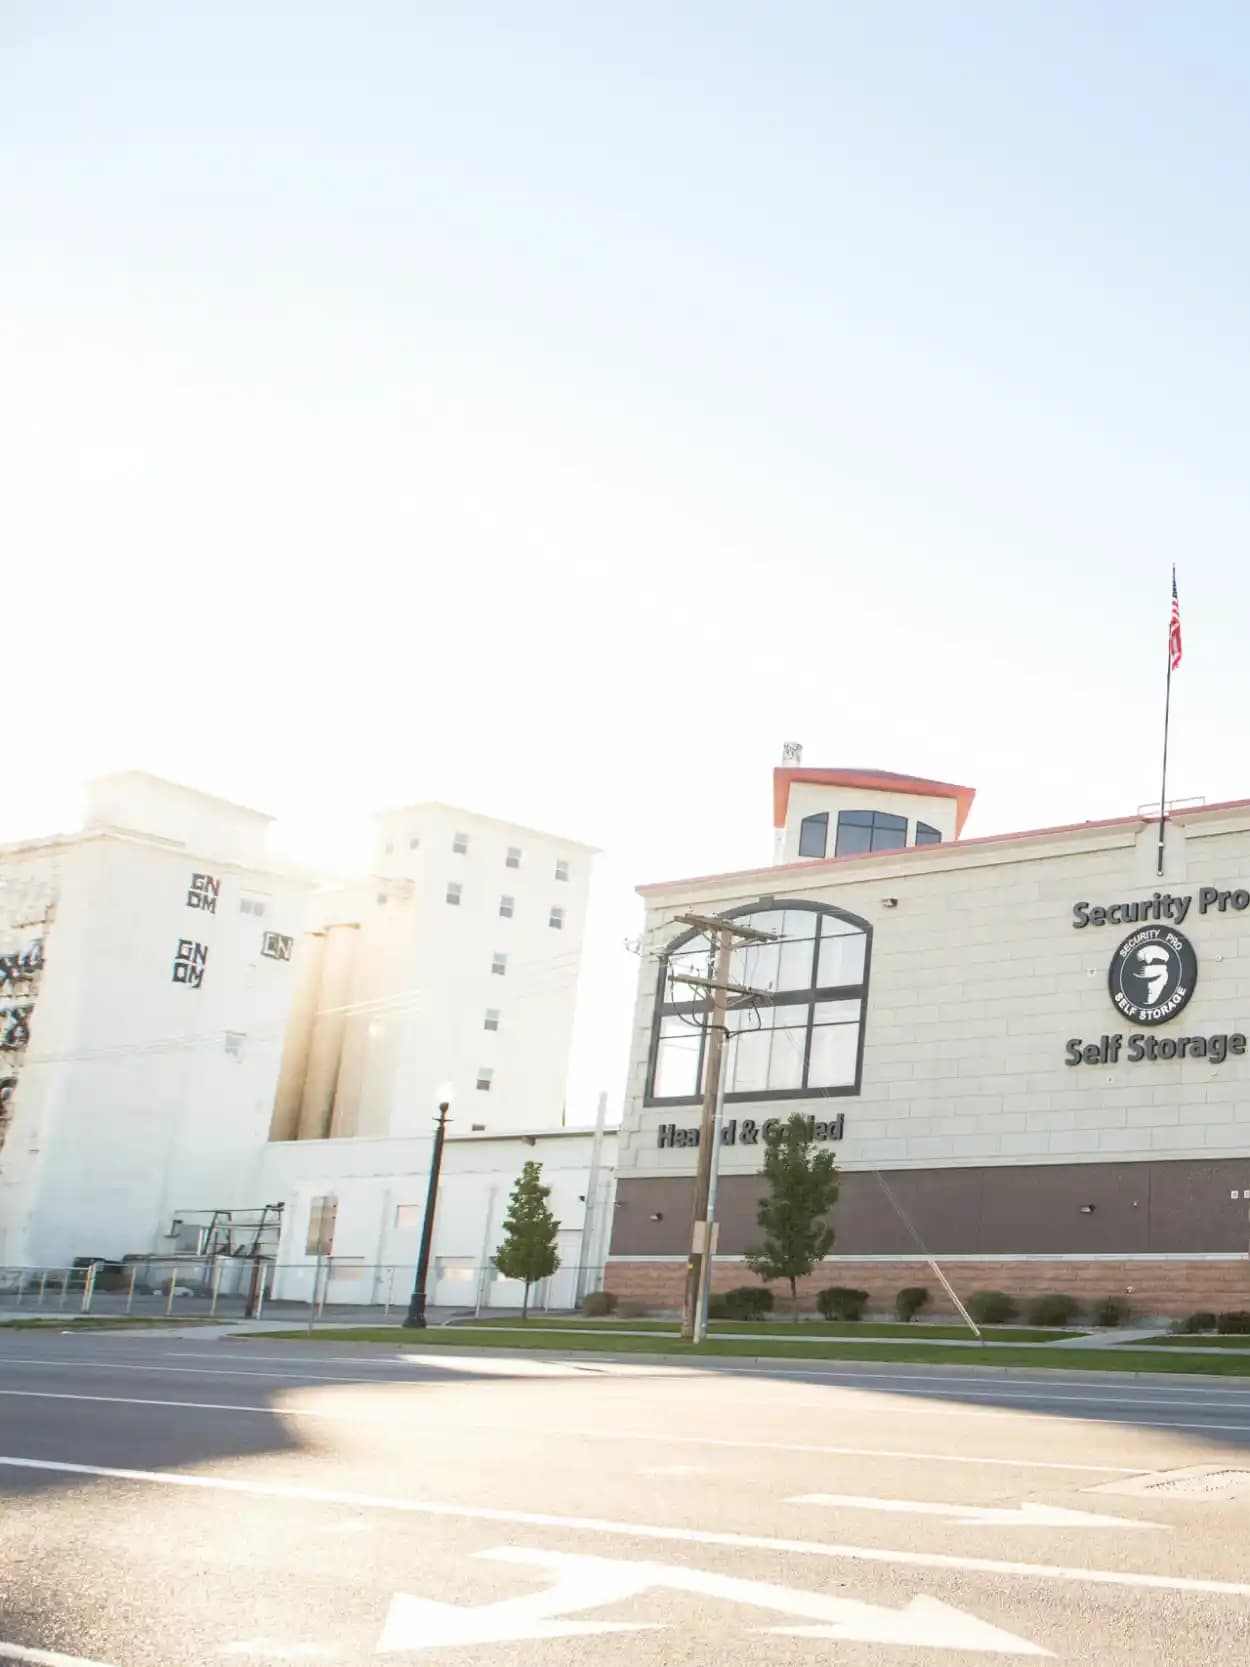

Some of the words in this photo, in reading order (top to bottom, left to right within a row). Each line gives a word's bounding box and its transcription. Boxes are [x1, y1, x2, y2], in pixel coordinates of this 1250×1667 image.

[1072, 893, 1191, 928] Security
[1199, 887, 1250, 914] Pro
[1119, 929, 1161, 958] SECURITY
[1166, 932, 1183, 951] PRO
[1114, 991, 1137, 1017] SELF
[1139, 985, 1187, 1021] STORAGE
[1064, 1034, 1122, 1066] Self
[1127, 1032, 1247, 1064] Storage
[657, 1119, 737, 1149] Head
[739, 1119, 759, 1145] &
